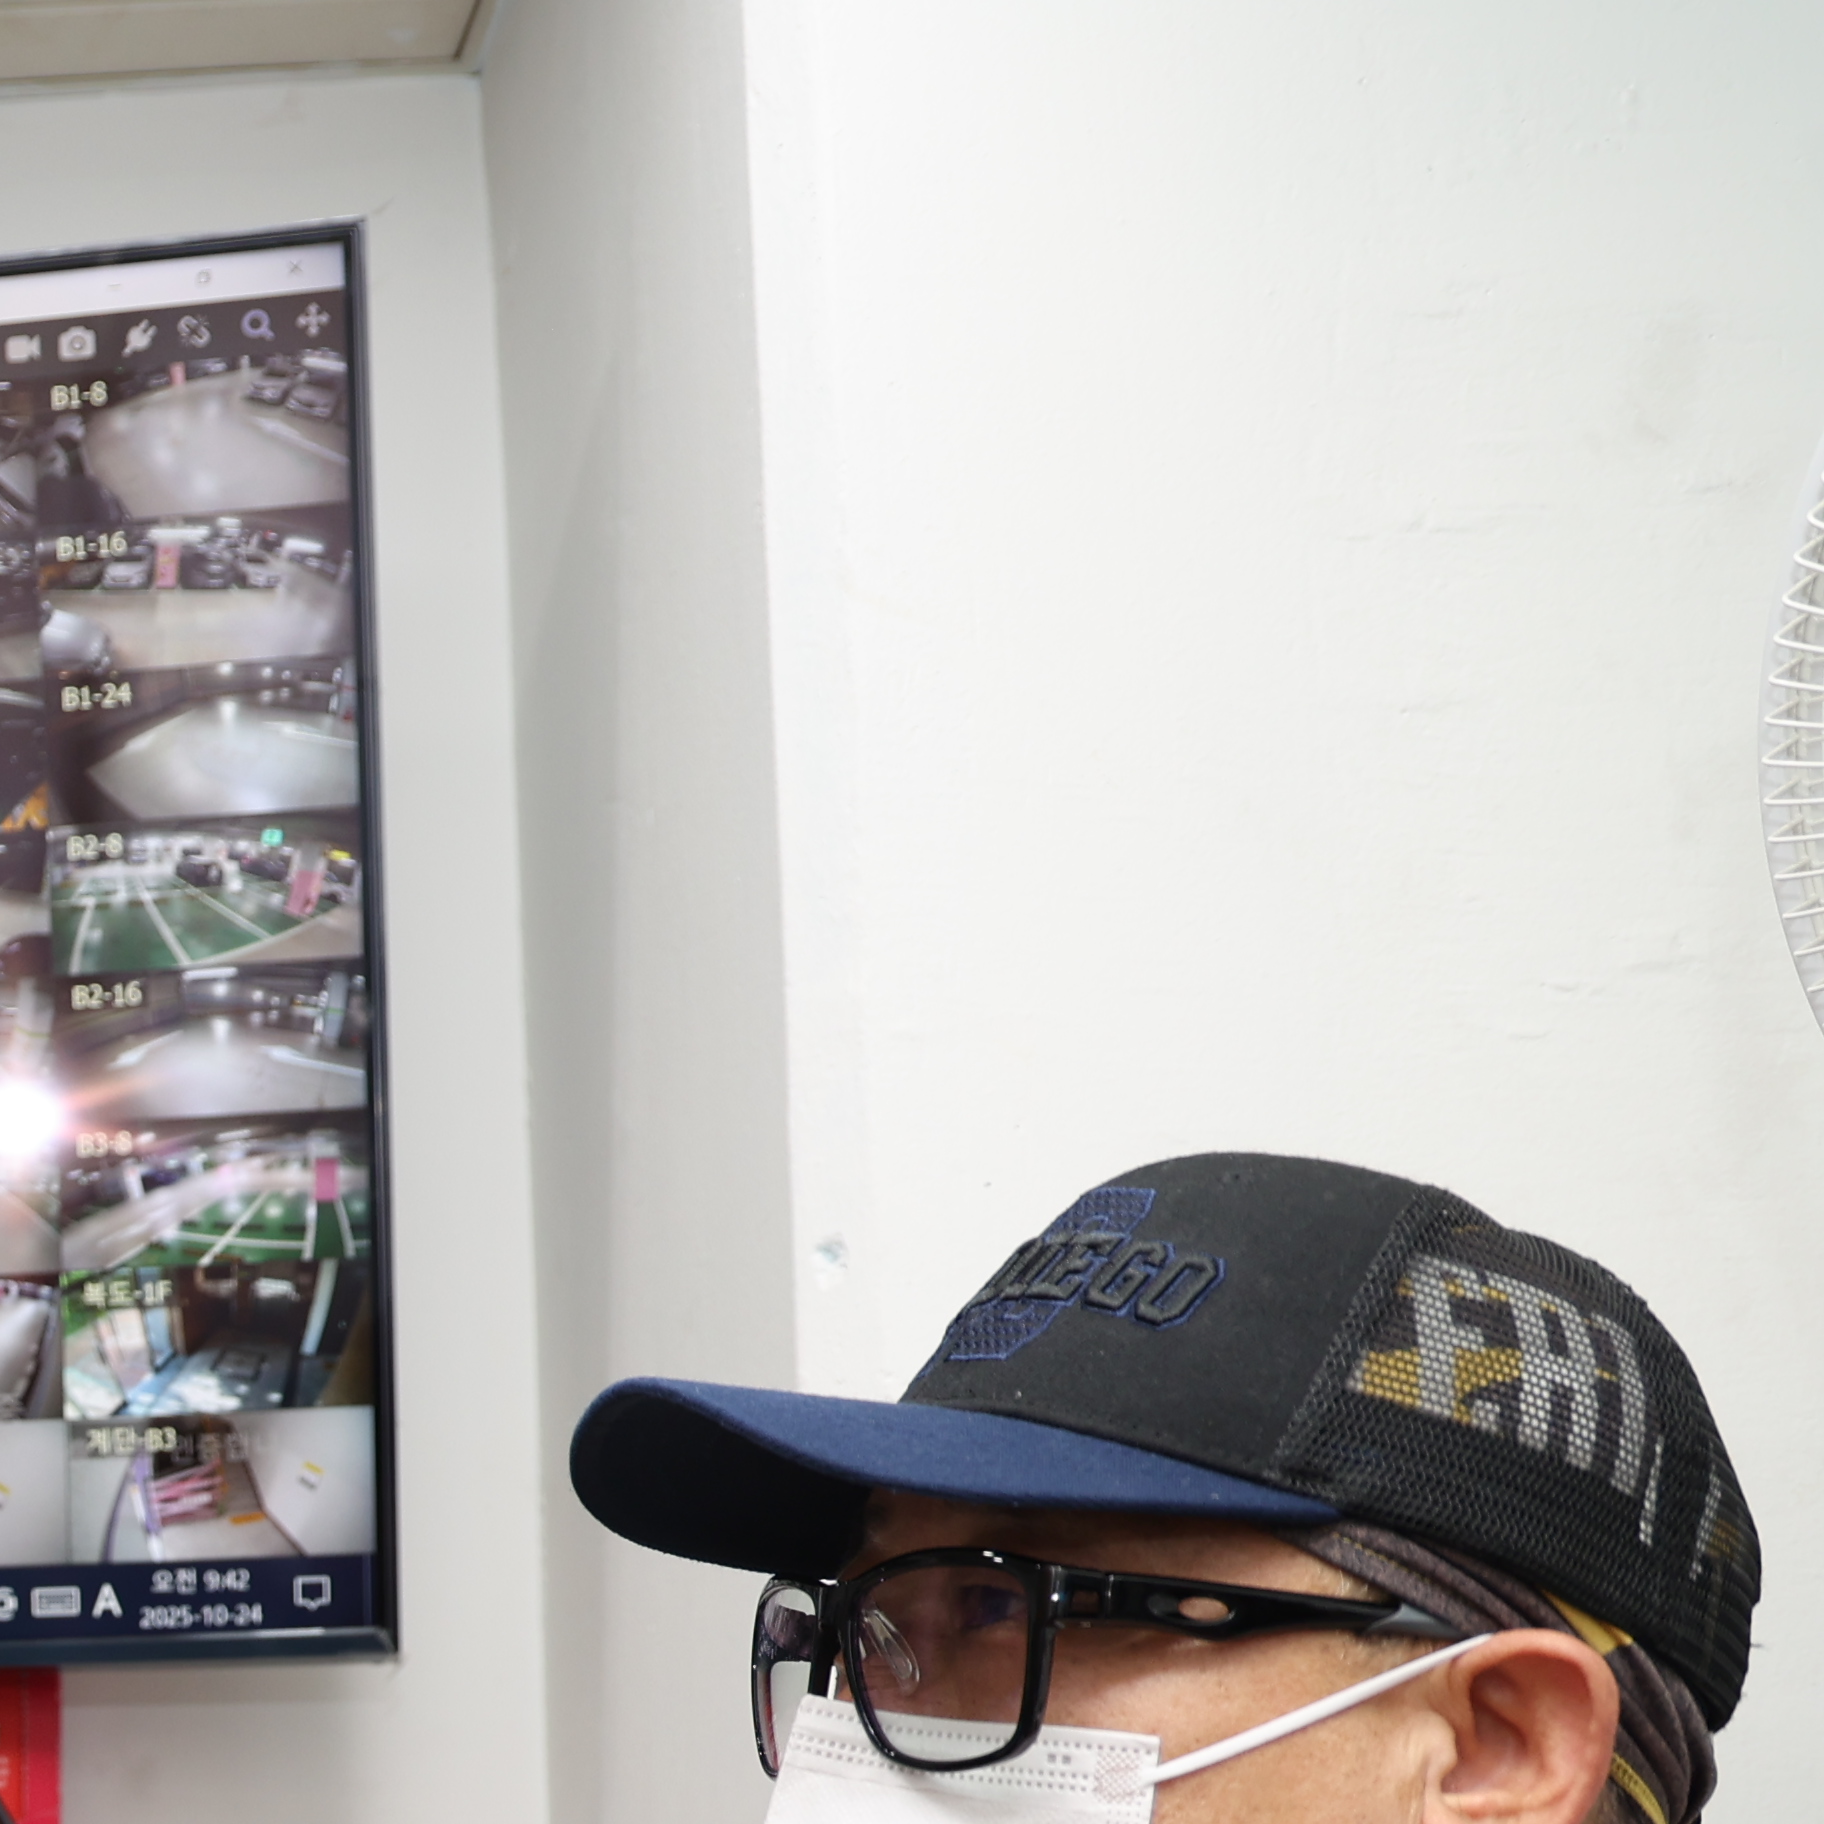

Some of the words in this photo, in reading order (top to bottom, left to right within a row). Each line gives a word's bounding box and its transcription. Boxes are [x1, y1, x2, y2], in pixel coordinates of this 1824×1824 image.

[49, 380, 108, 410] B1-8
[56, 531, 128, 561] B1-16
[61, 682, 131, 711] B1-24
[66, 833, 124, 862] B2-8
[71, 980, 142, 1009] B2-16
[76, 1130, 134, 1157] B3-8
[87, 1427, 177, 1456] 계단-B3
[151, 1567, 197, 1595] 오전
[203, 1567, 251, 1593] 9:42
[139, 1602, 263, 1630] 2025-10-24
